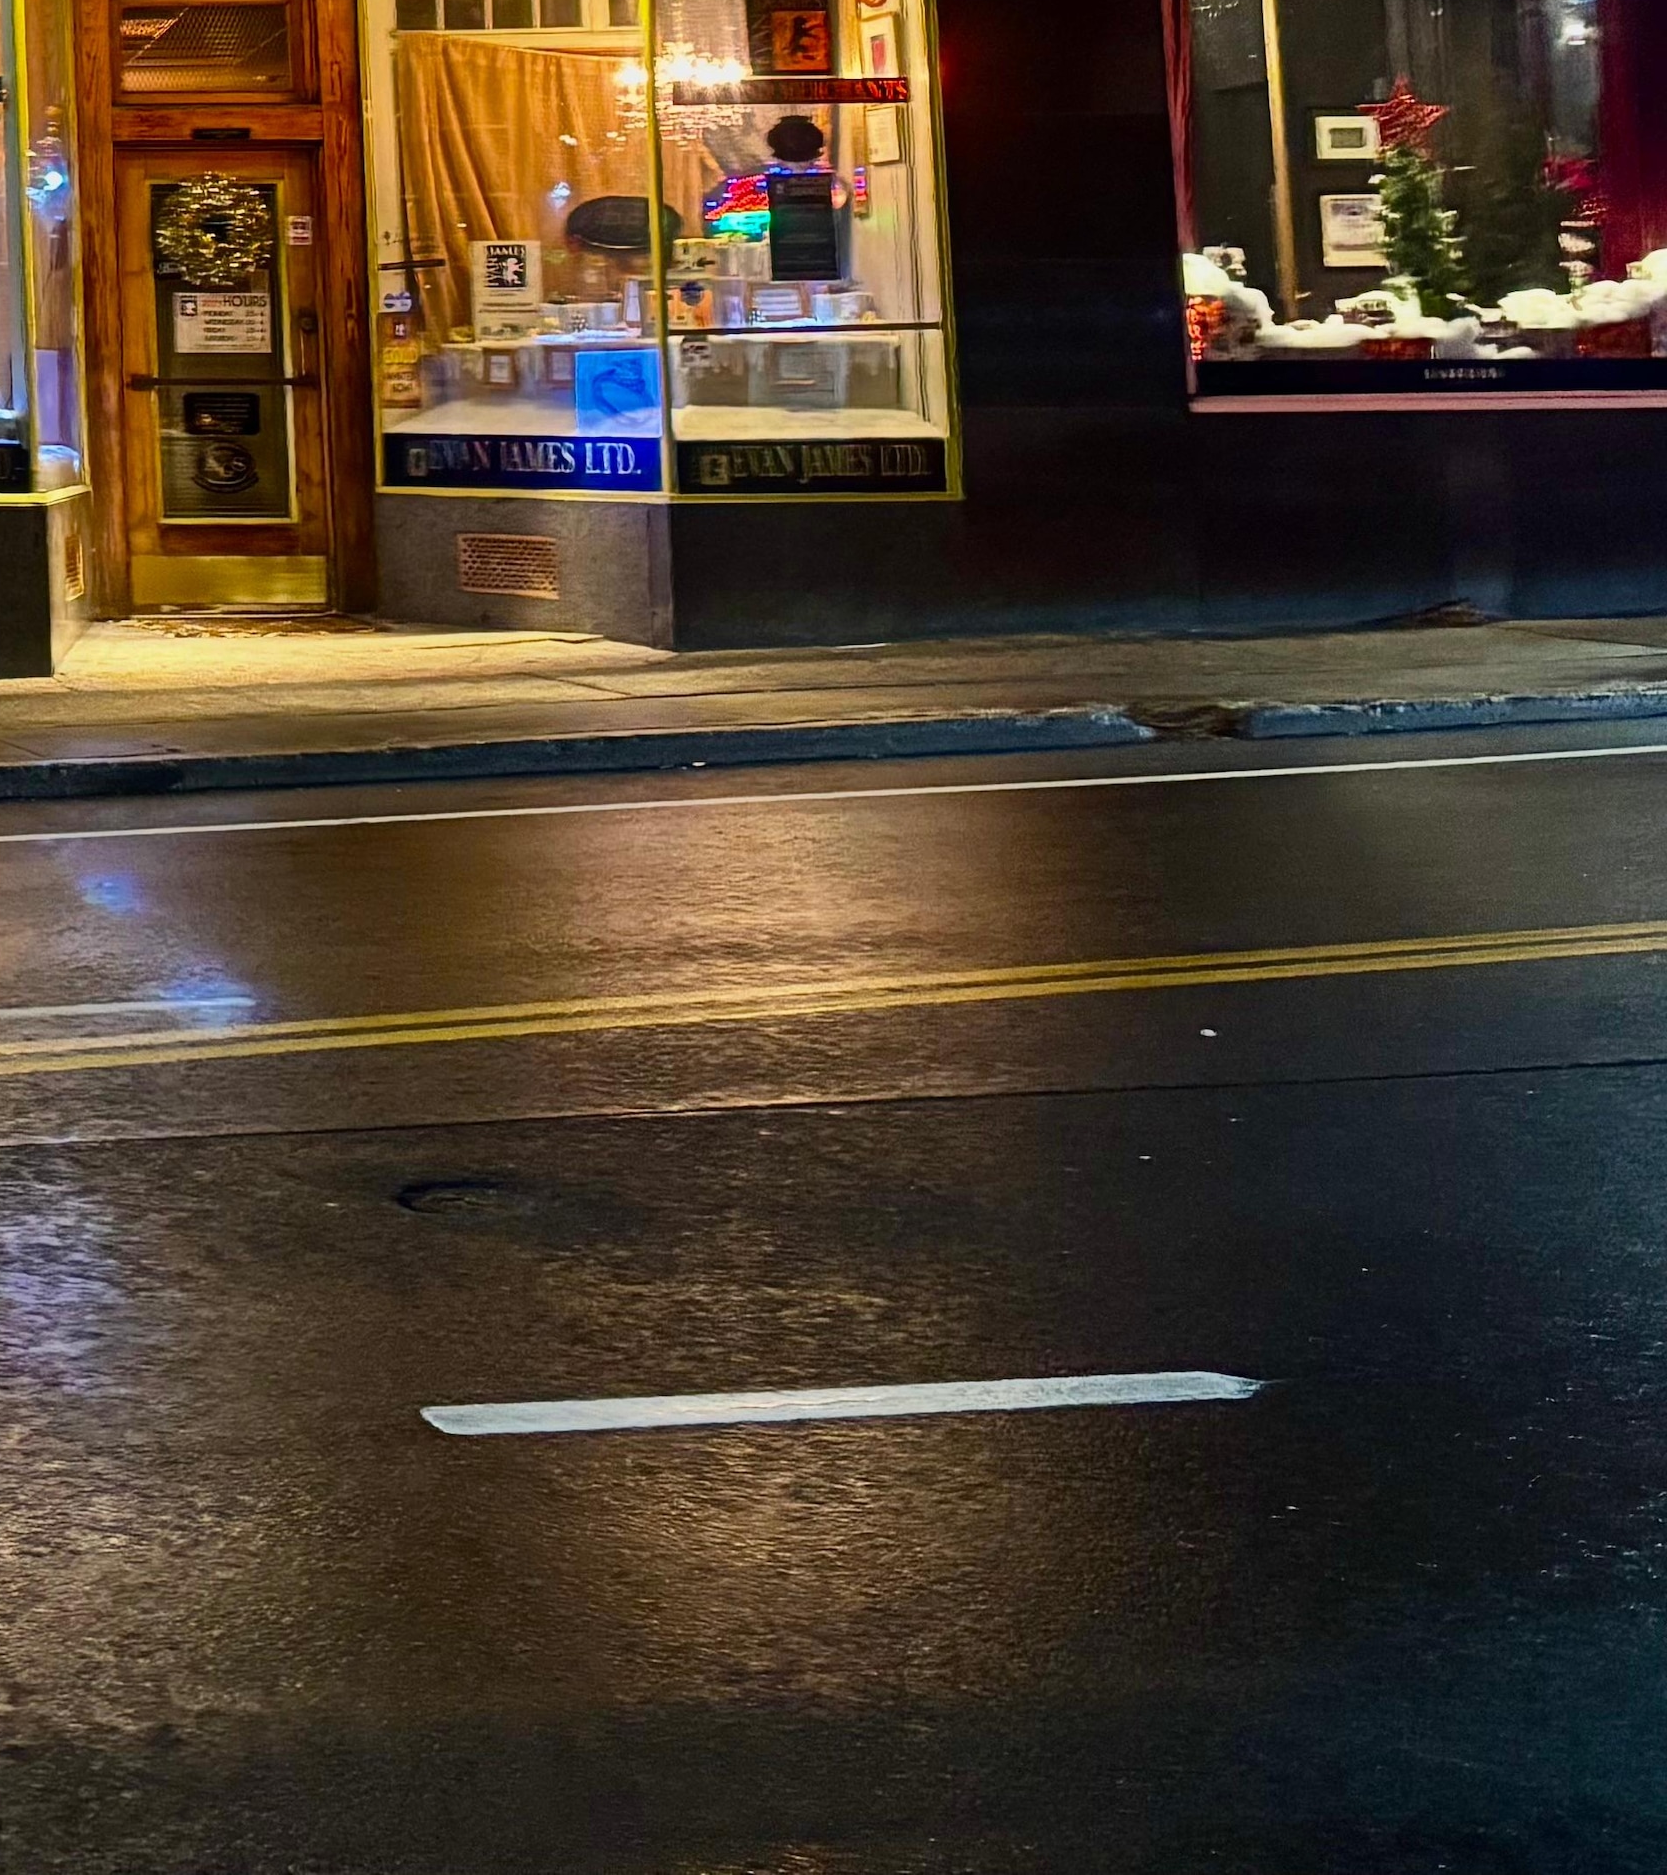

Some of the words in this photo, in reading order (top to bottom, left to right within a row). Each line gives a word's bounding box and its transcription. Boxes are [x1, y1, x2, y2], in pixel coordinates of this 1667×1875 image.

[223, 295, 267, 307] HOURS
[428, 441, 492, 473] EVAN
[499, 440, 576, 475] JAMES
[584, 441, 643, 476] LTD.
[729, 444, 796, 478] EVAN
[796, 444, 874, 485] JAMES
